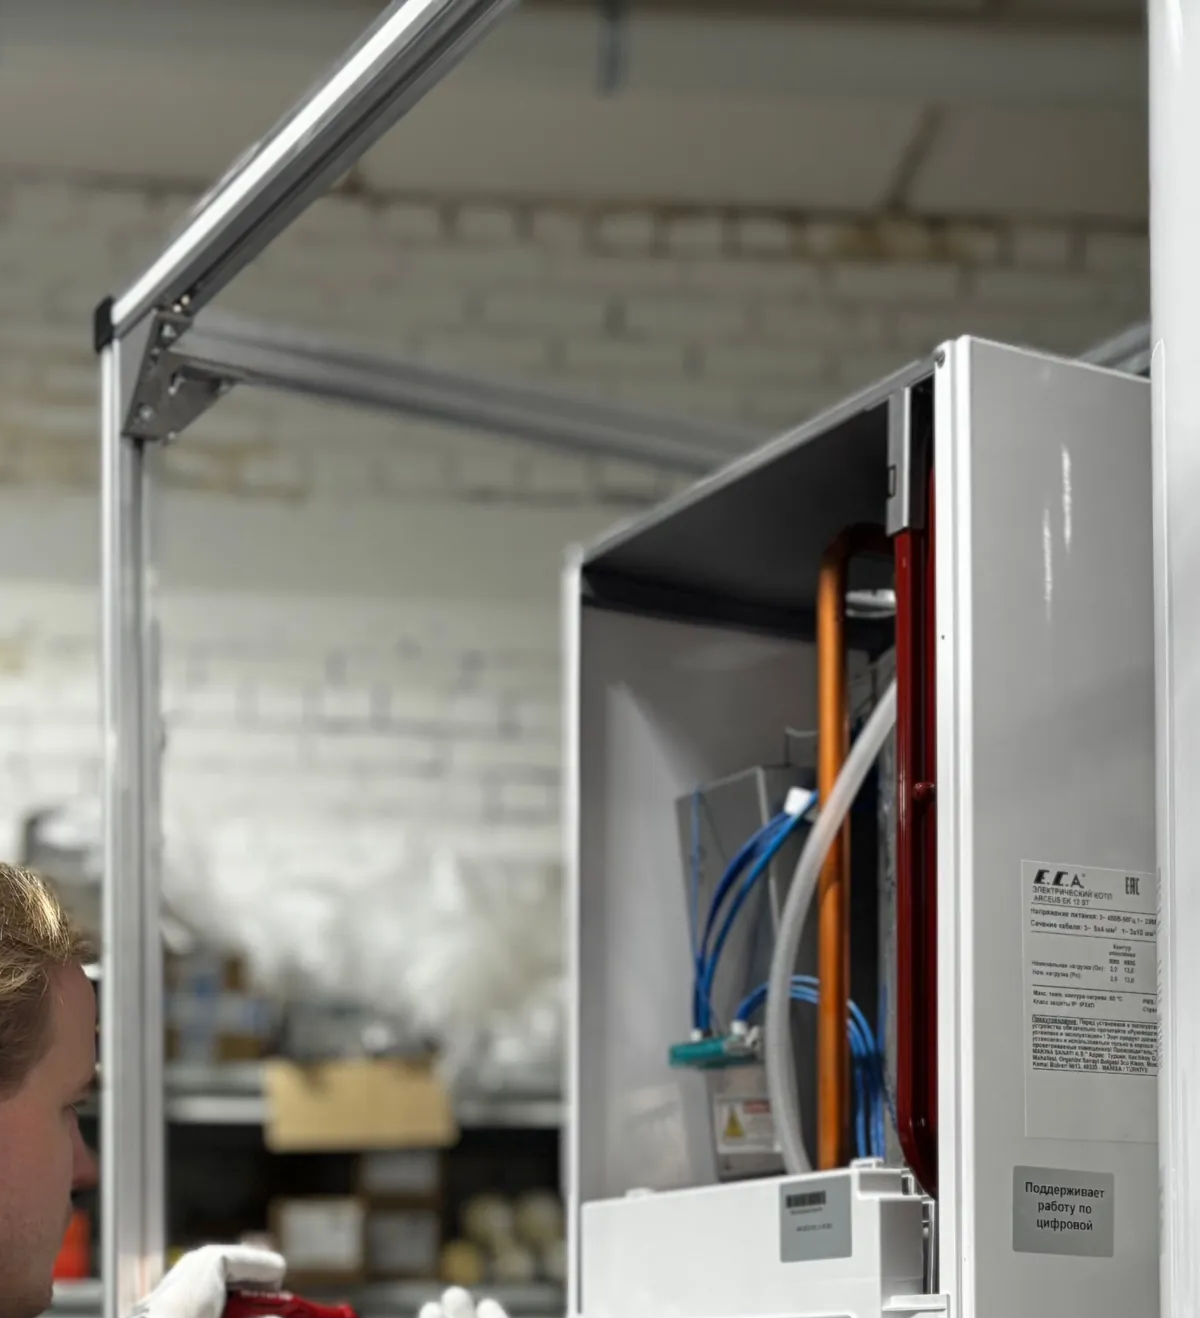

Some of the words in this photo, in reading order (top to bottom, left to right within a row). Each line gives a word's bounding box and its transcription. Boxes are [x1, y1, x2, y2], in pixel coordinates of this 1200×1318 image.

[1032, 885, 1092, 898] ЭЛЕКТРИЧЕСКИЙ
[1034, 895, 1061, 903] ARCEUS
[1025, 1181, 1105, 1198] Поддерживает
[1037, 1201, 1076, 1216] работу
[1079, 1204, 1092, 1214] по
[1036, 1217, 1094, 1232] цифровой
